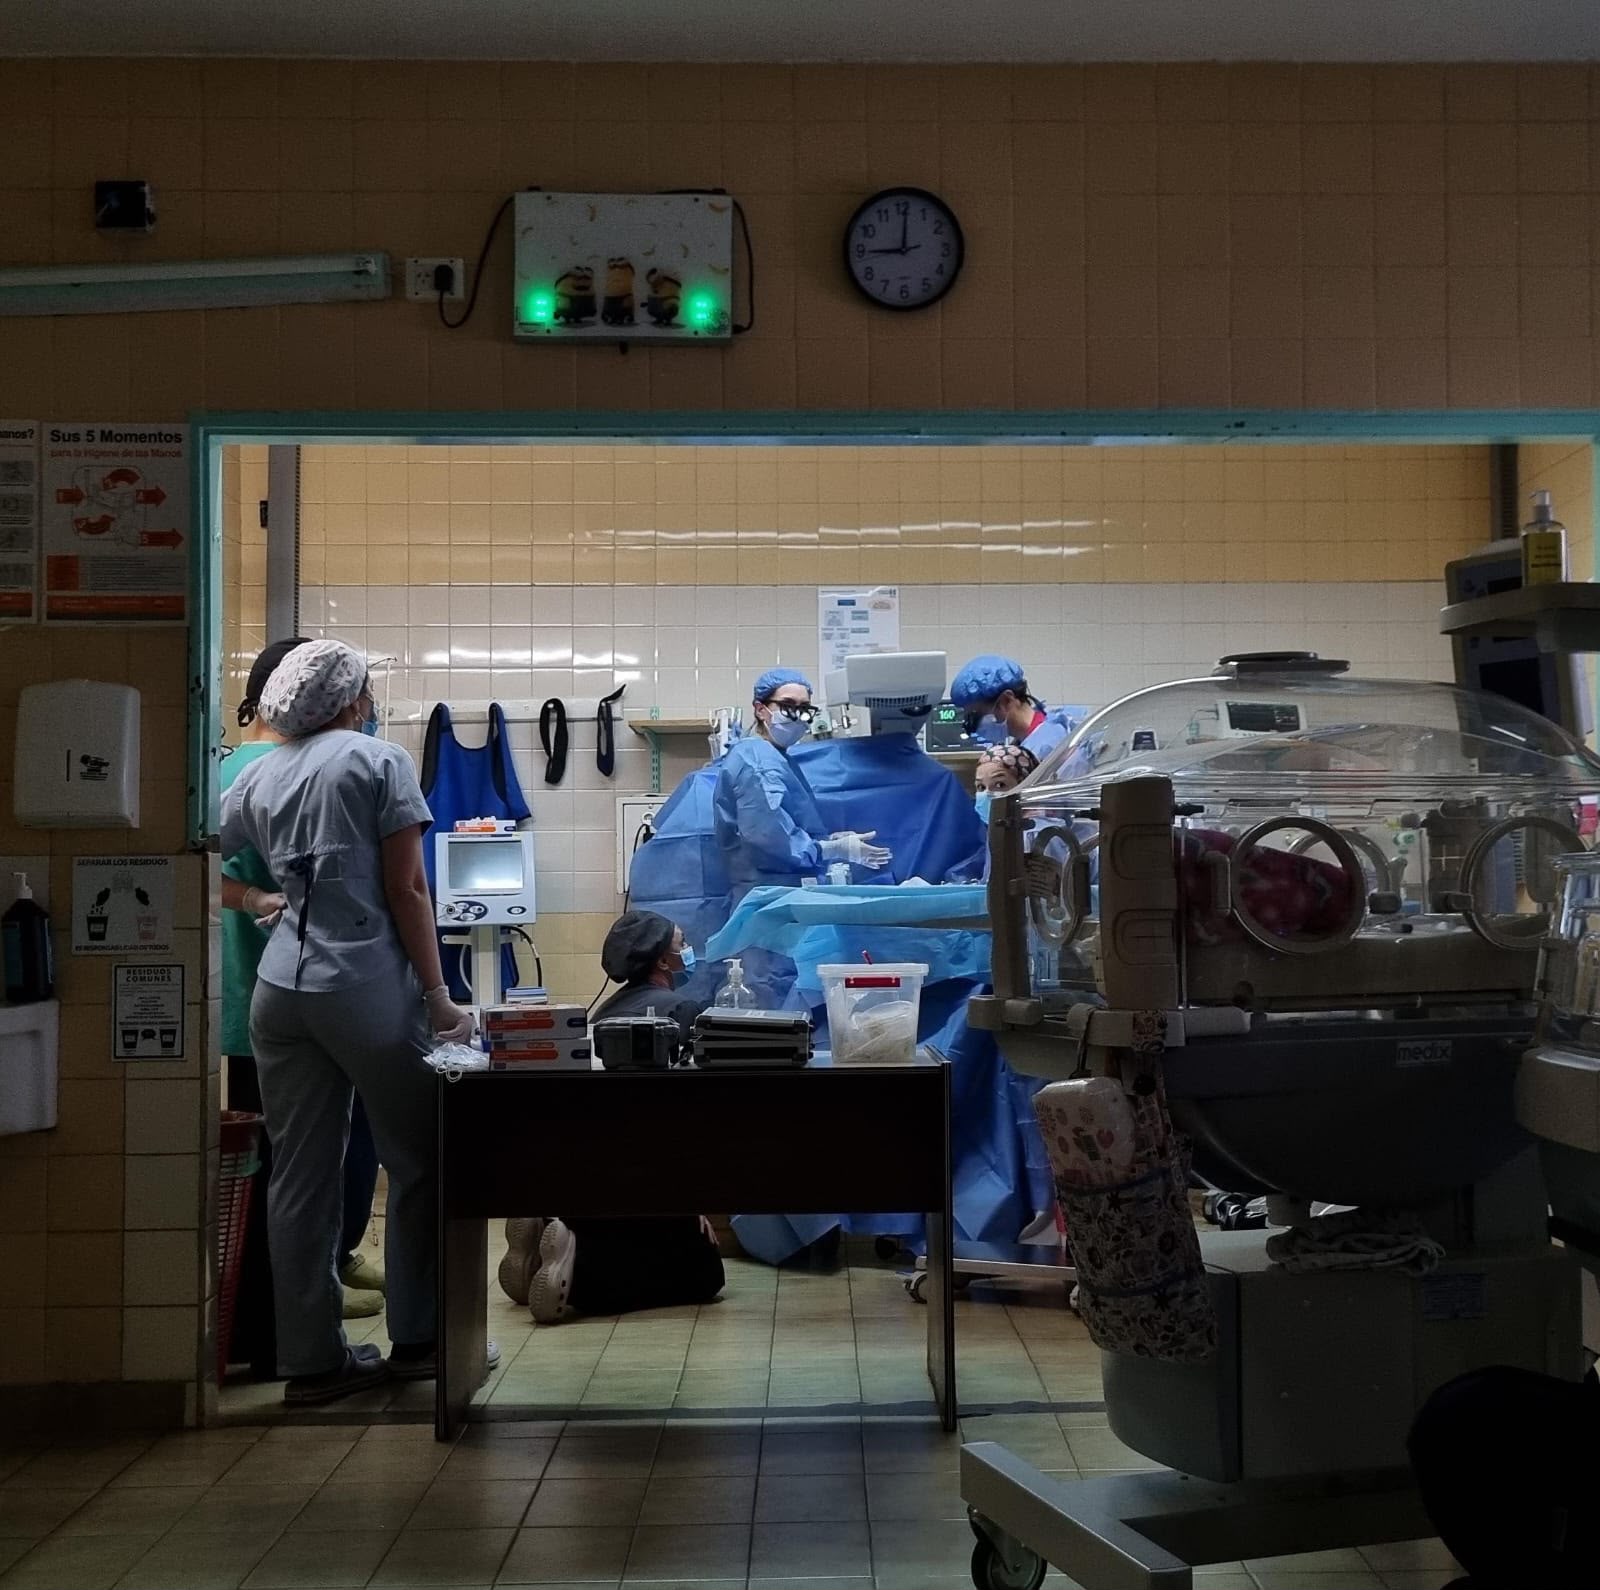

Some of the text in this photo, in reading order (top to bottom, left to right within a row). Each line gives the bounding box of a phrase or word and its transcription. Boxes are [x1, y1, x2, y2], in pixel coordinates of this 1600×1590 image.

[876, 208, 889, 222] 11
[895, 201, 910, 216] 12
[920, 208, 927, 221] 1
[860, 223, 876, 239] 10
[933, 220, 944, 235] 2
[856, 243, 865, 259] 9
[941, 242, 951, 258] 3
[864, 266, 874, 281] 8
[936, 263, 944, 276] 4
[880, 280, 890, 294] 7
[900, 284, 910, 300] 6
[921, 277, 931, 293] 5
[50, 429, 183, 443] Sus 5 Momentos
[50, 450, 72, 458] para
[121, 449, 134, 457] de
[136, 449, 149, 457] las
[151, 449, 182, 458] Manos
[939, 710, 956, 720] 160
[129, 858, 168, 866] RESIDUOS
[1398, 1043, 1450, 1061] medix
